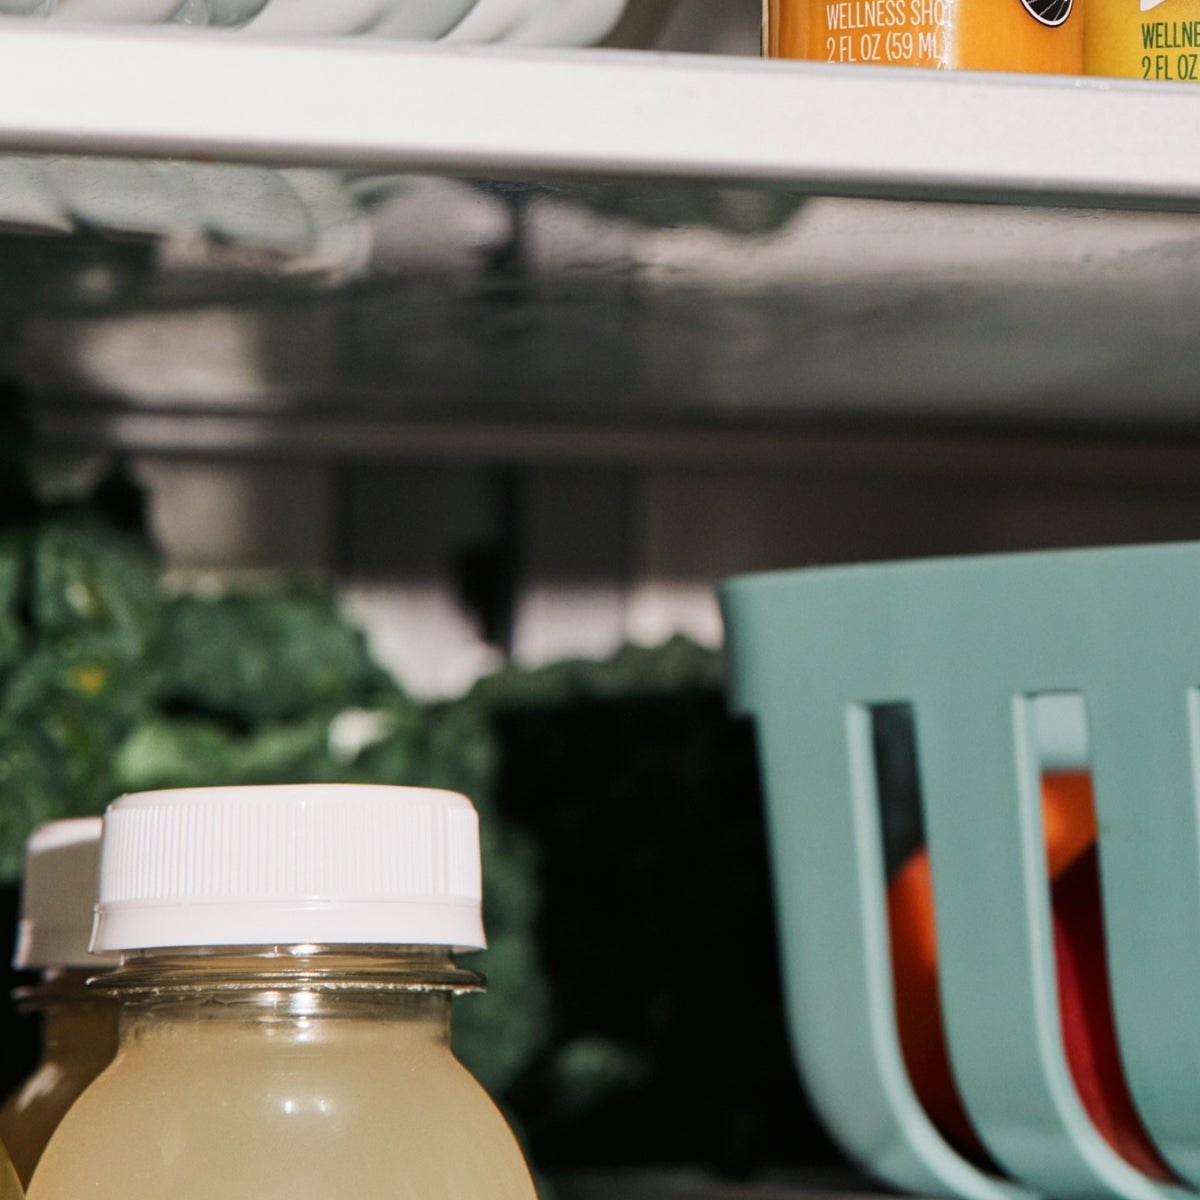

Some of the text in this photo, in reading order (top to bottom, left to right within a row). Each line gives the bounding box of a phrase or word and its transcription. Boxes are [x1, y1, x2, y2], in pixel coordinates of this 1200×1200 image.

[826, 0, 906, 30] WELLNESS
[826, 37, 836, 63] 2
[840, 36, 856, 62] FL
[860, 34, 880, 61] OZ
[886, 31, 913, 61] (59
[1141, 55, 1151, 80] 2
[1156, 55, 1173, 80] FL
[1177, 54, 1198, 80] OZ
